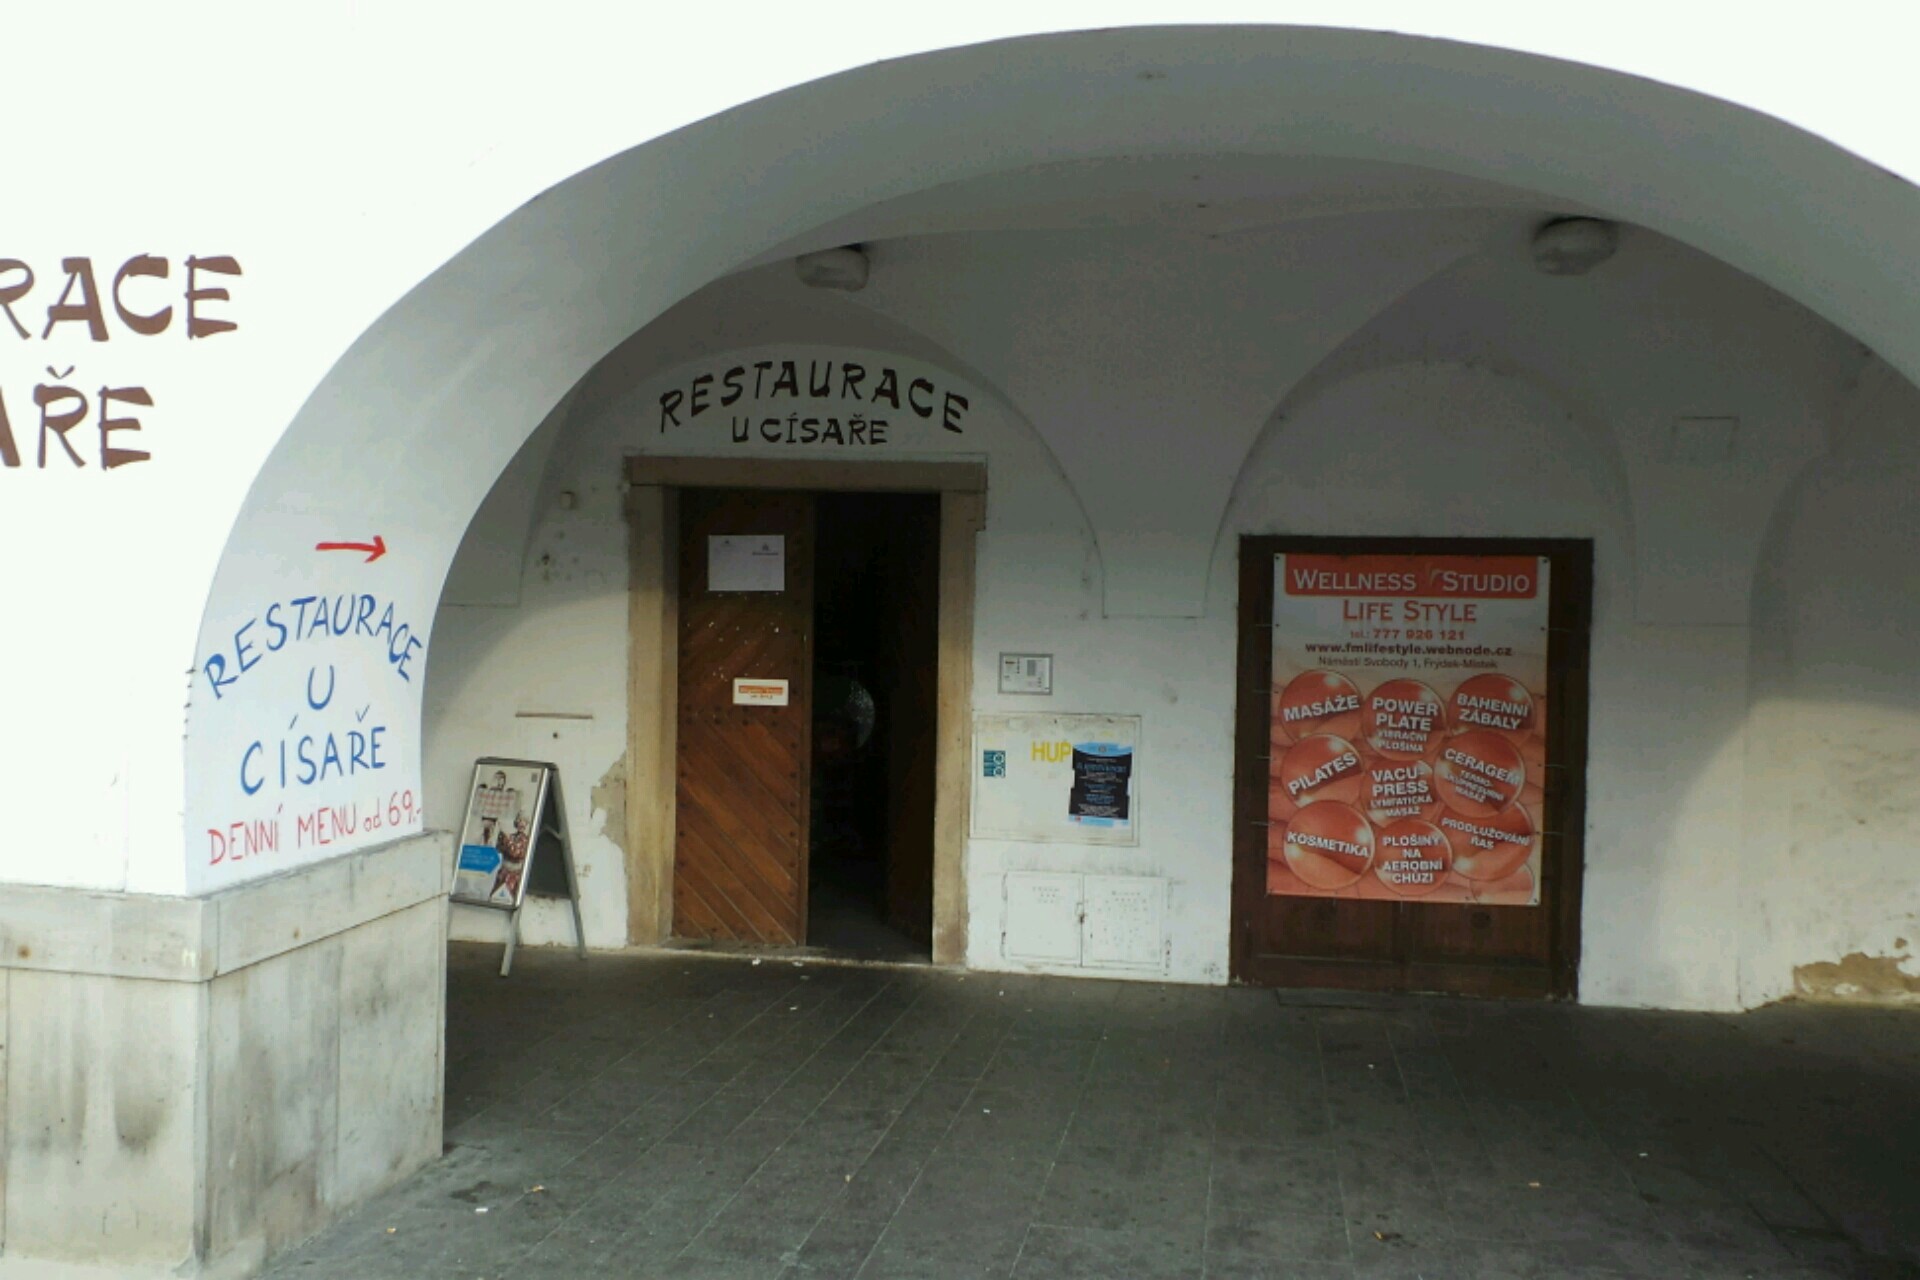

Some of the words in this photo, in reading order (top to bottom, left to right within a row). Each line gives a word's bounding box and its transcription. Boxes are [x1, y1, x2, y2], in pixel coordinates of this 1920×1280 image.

[658, 359, 969, 434] RESTAURACE
[732, 416, 750, 443] U
[759, 411, 889, 445] CÍSAŘE
[1293, 569, 1417, 591] WELLNESS
[1442, 571, 1531, 593] STUDIO
[1342, 599, 1394, 621] LIFE
[1403, 600, 1478, 622] STYLE
[202, 593, 422, 699] RESTAURACE
[1373, 629, 1401, 640] 777
[1440, 630, 1466, 641] 121
[1305, 642, 1514, 658] www.fmlifestyle.webnode.cz
[1363, 657, 1410, 669] Svobody
[306, 665, 335, 711] U
[1283, 694, 1360, 722] MASÁŽE
[1372, 697, 1439, 717] POWER
[1456, 692, 1529, 718] BAHENNÍ
[1375, 713, 1433, 732] PLATE
[1458, 707, 1523, 730] ZÁBALY
[240, 704, 387, 796] CÍSAŘE
[1031, 740, 1073, 764] HUP
[1288, 751, 1358, 795] PILATES
[1444, 747, 1521, 785] CERAGEM
[1372, 780, 1429, 798] PRESS
[206, 804, 284, 867] DENNÍ
[296, 803, 358, 850] MENU
[364, 810, 383, 834] od
[1286, 832, 1370, 858] KOSMETIKA
[1382, 834, 1442, 847] PLOŠINY
[1382, 857, 1444, 871] AEROBNÍ
[1401, 848, 1422, 860] NA
[1391, 870, 1435, 885] CHŮZI
